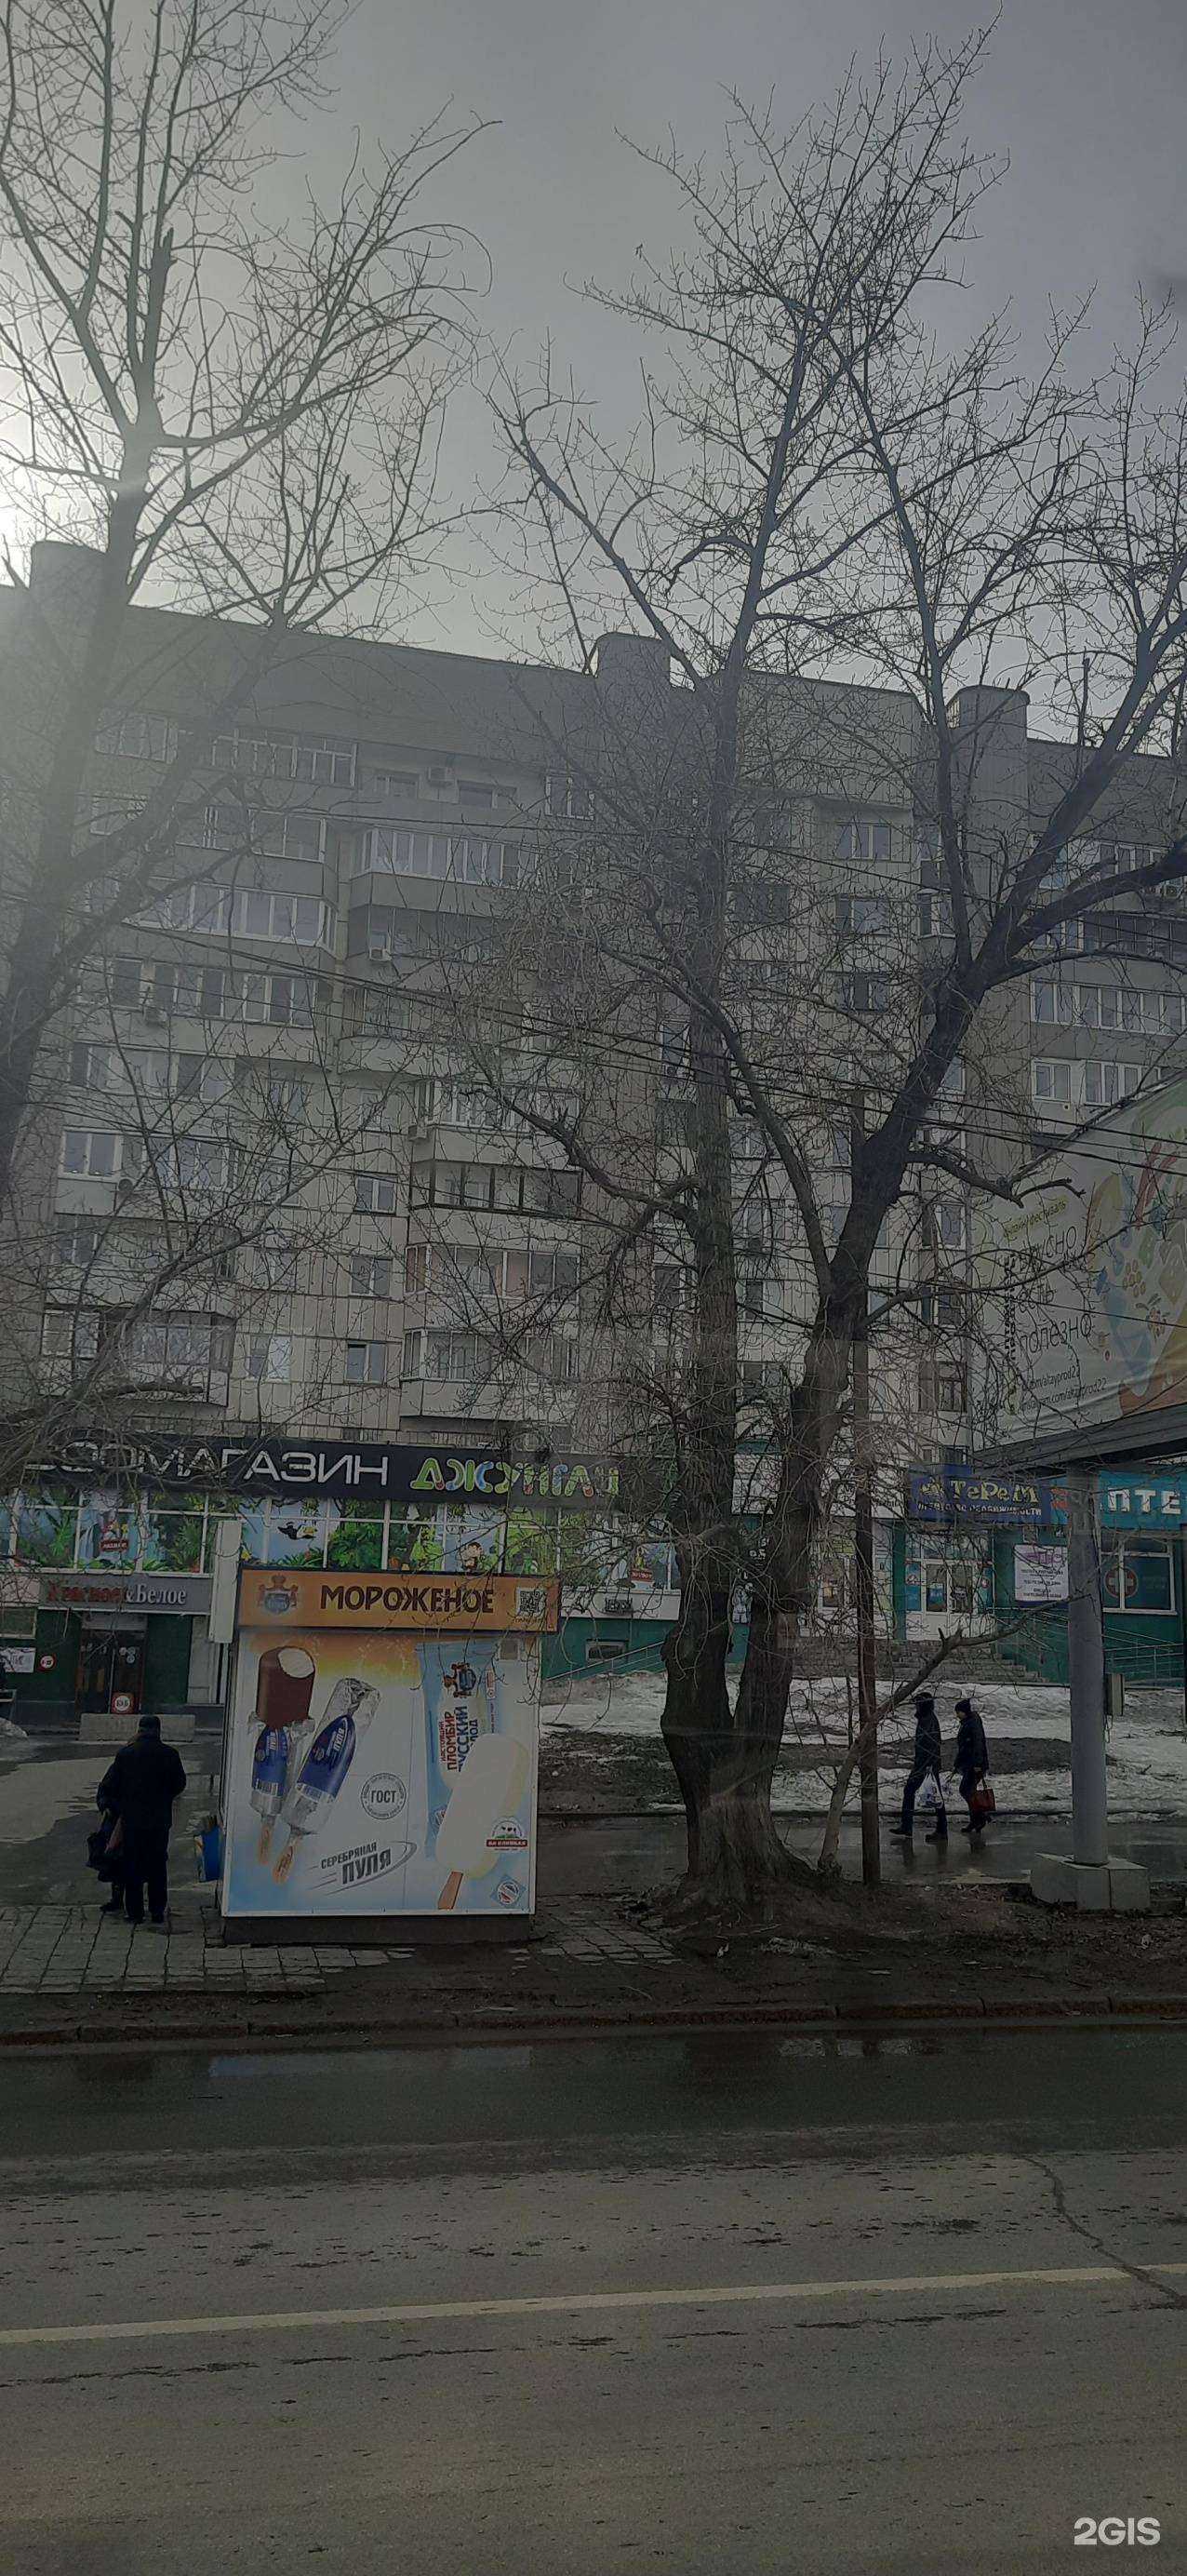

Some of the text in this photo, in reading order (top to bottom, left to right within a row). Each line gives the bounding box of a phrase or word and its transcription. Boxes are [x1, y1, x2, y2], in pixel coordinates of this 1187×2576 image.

[1098, 1486, 1181, 1514] ПТЕ
[320, 1584, 494, 1613] МОРОЖЕНОЕ
[445, 1711, 458, 1771] ПЛОМБИР
[371, 1790, 396, 1804] ГОСТ
[342, 1848, 392, 1885] ПУЛЯ
